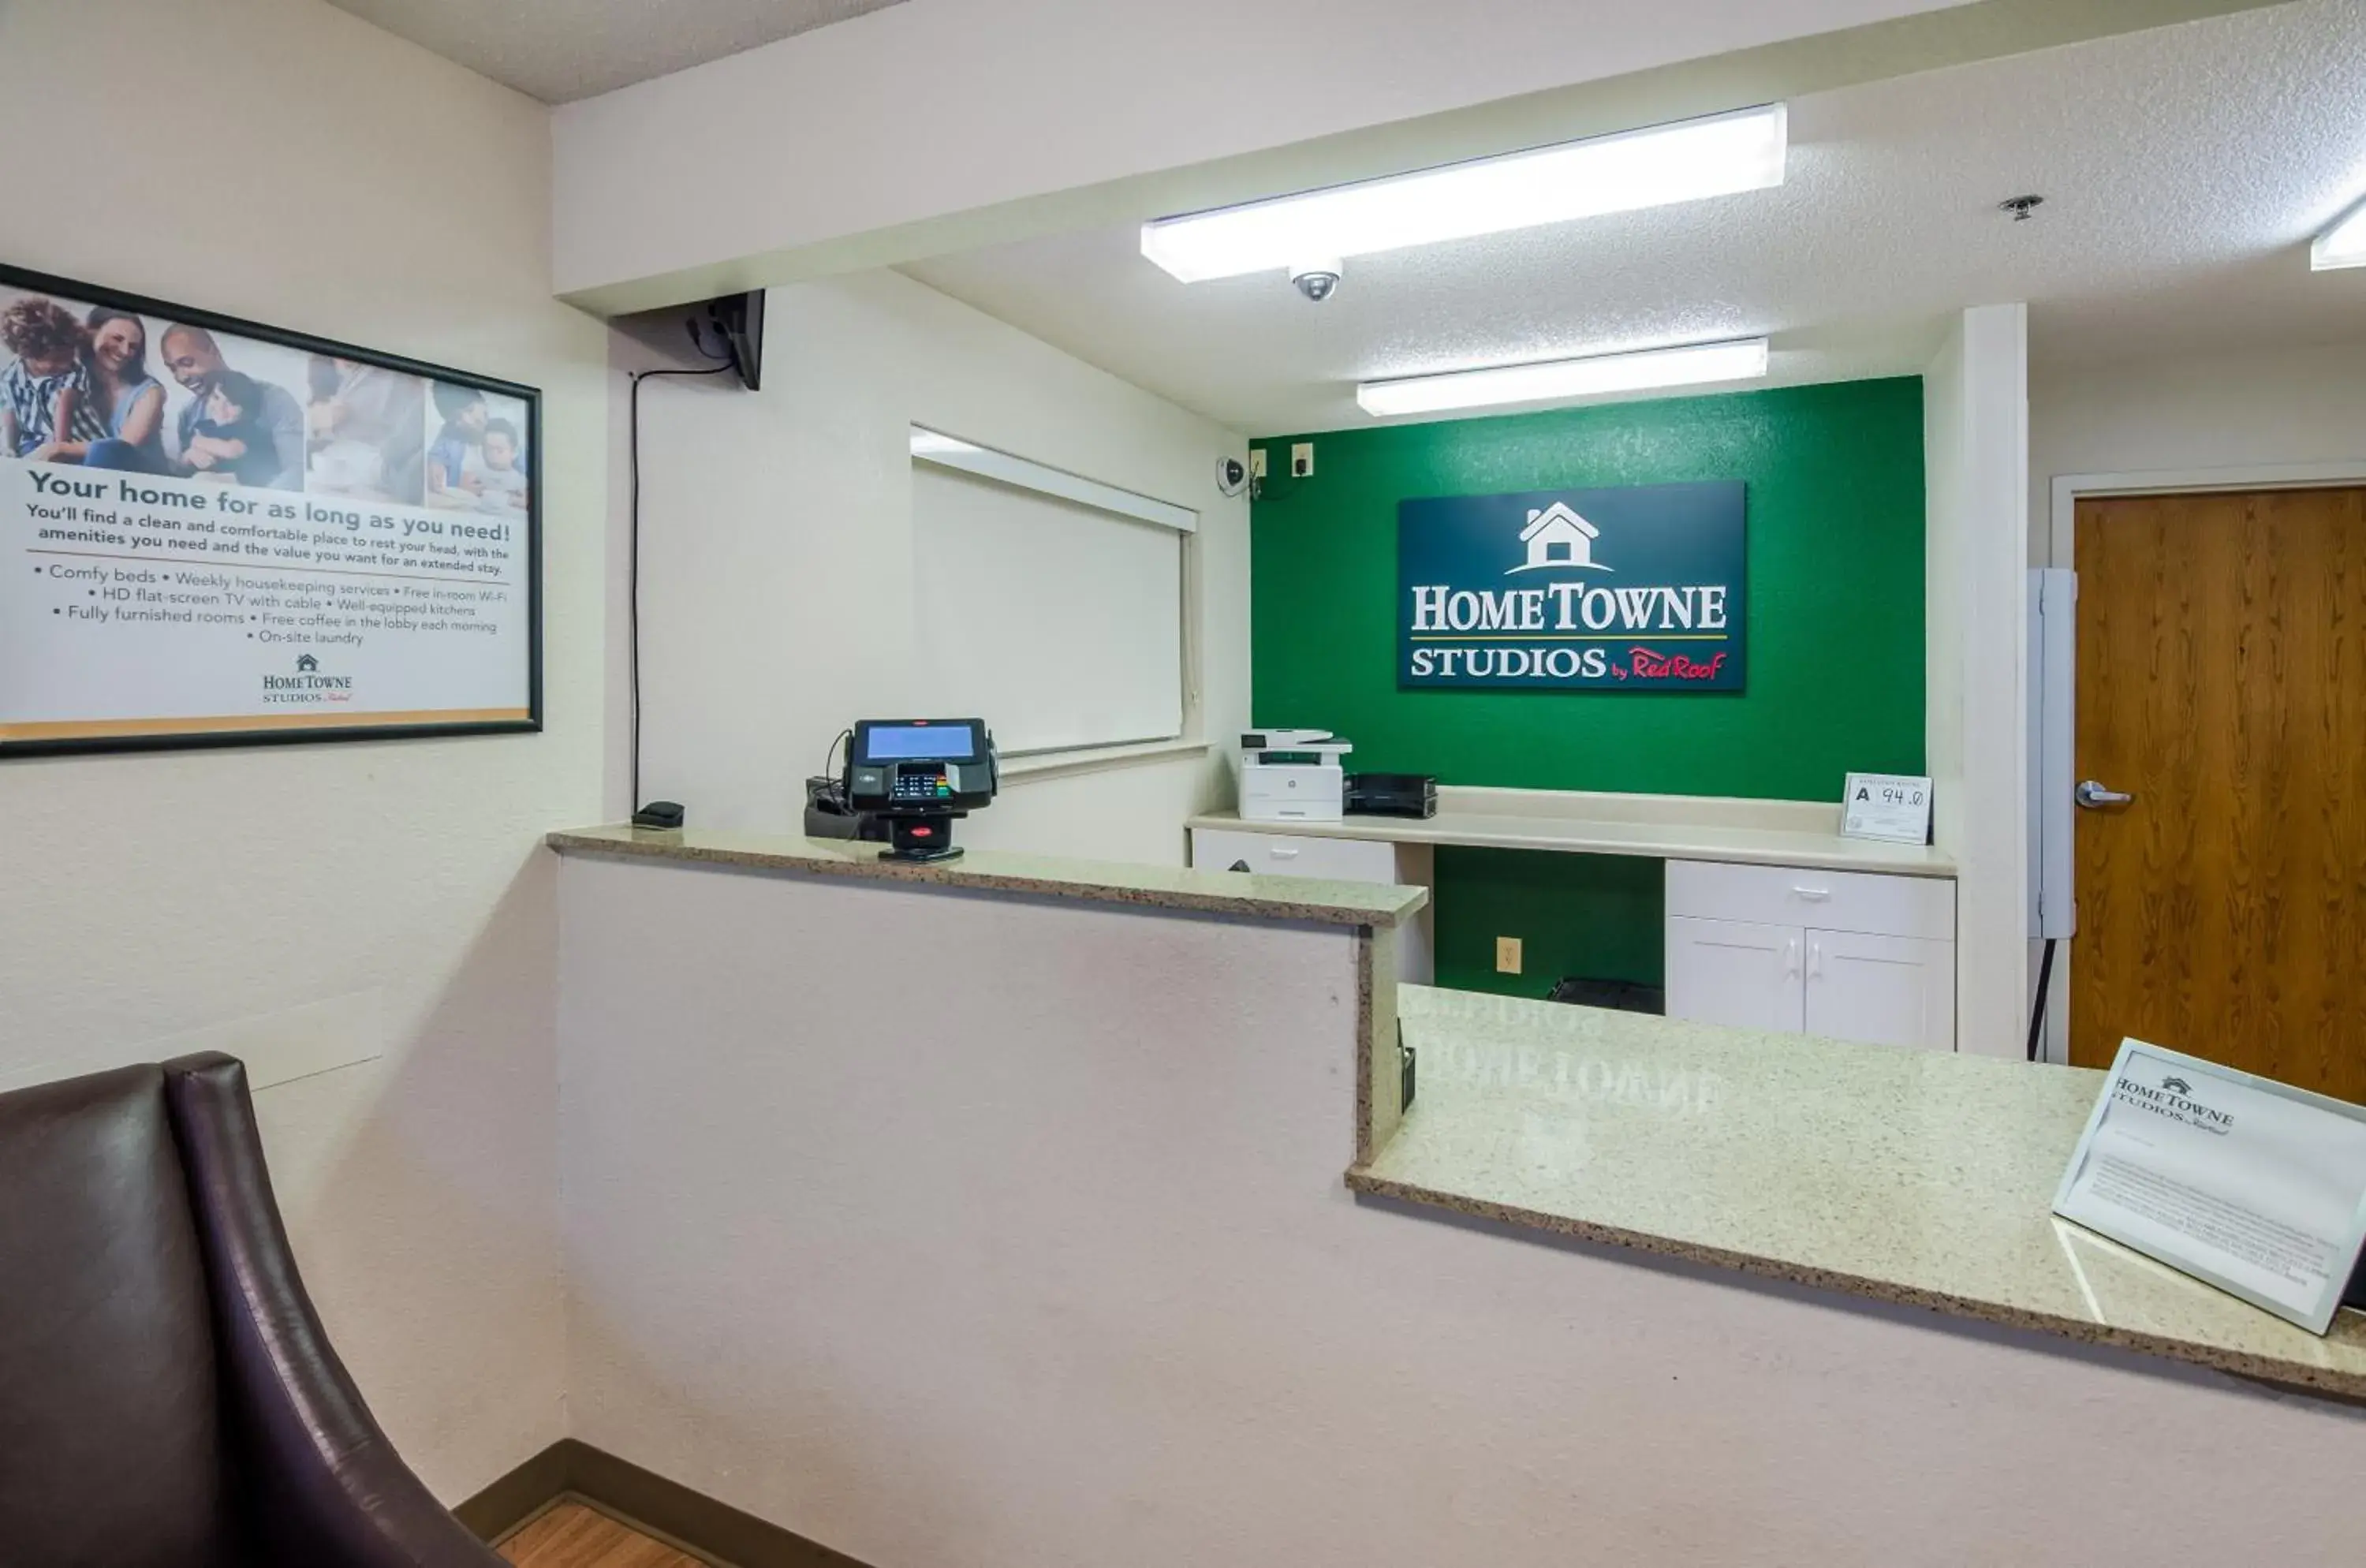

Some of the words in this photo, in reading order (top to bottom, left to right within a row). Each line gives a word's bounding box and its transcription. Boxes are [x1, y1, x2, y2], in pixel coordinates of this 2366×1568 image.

[27, 469, 109, 498] Your
[120, 480, 207, 509] home
[217, 491, 259, 514] for
[268, 503, 297, 519] as
[305, 502, 360, 531] long
[370, 514, 394, 529] as
[403, 518, 443, 536] you
[450, 524, 510, 541] need!
[26, 504, 77, 521] You'll
[84, 509, 117, 525] find
[123, 517, 132, 526] a
[138, 514, 181, 530] clean
[187, 521, 215, 533] and
[220, 525, 308, 542] comfortable
[313, 531, 348, 547] place
[353, 536, 366, 547] to
[371, 538, 396, 548] rest
[400, 542, 426, 553] your
[464, 546, 488, 558] with
[491, 547, 509, 559] the
[39, 528, 125, 544] amenities
[131, 536, 162, 549] you
[169, 538, 207, 551] need
[212, 540, 239, 553] and
[245, 542, 268, 555] the
[274, 546, 311, 559] value
[315, 551, 340, 563] you
[345, 553, 376, 564] want
[382, 554, 399, 566] for
[403, 558, 417, 567] an
[420, 559, 474, 572] extended
[49, 564, 109, 584] Comfy
[114, 568, 156, 583] beds
[176, 572, 231, 590] Weekly
[237, 575, 335, 596] housekeeping
[340, 584, 390, 596] services
[404, 586, 430, 599] Free
[433, 588, 476, 602] in-room
[103, 587, 130, 600] HD
[136, 587, 219, 606] flat-screen
[225, 592, 244, 606] TV
[250, 595, 280, 607] with
[285, 597, 321, 609] cable
[430, 603, 476, 616] kitchens
[68, 605, 109, 624] Fully
[114, 607, 192, 622] furnished
[197, 612, 244, 624] rooms
[263, 612, 294, 625] Free
[299, 613, 341, 627] coffee
[345, 616, 356, 627] in
[360, 616, 380, 628] the
[384, 616, 417, 631] lobby
[421, 619, 448, 631] each
[259, 629, 311, 643] On-site
[315, 631, 363, 648] laundry
[1411, 648, 1607, 678] STUDIOS
[1611, 662, 1628, 681] by
[263, 693, 322, 703] STUDIOS
[1856, 786, 1870, 801] A
